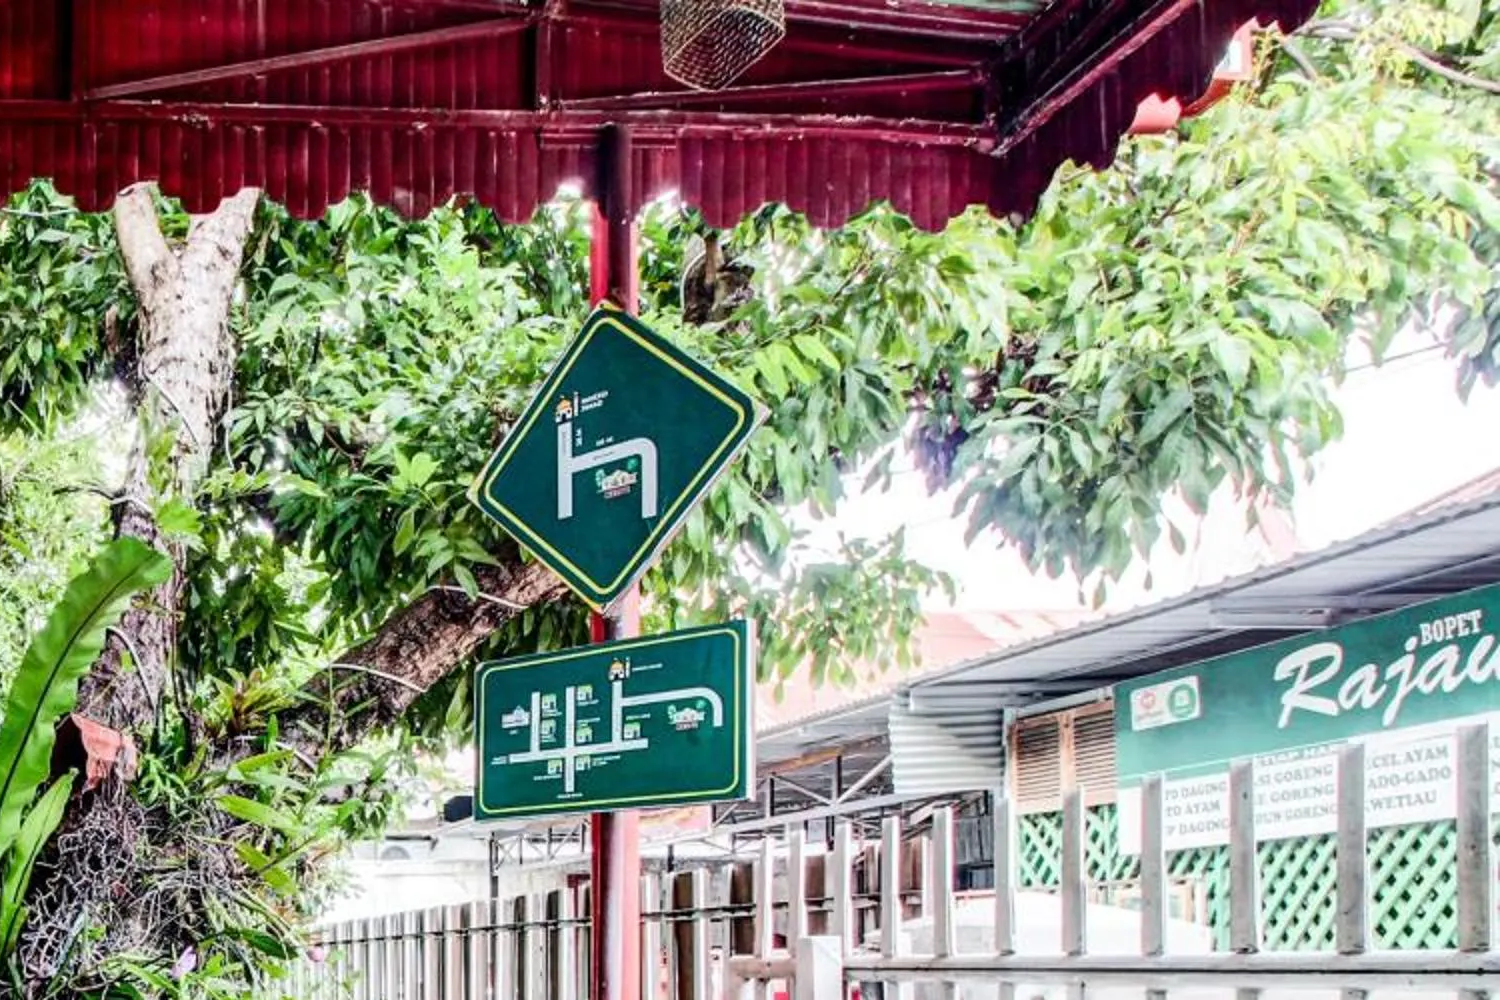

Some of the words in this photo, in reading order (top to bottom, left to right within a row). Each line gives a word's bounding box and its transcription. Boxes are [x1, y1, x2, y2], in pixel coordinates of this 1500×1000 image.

[1420, 609, 1482, 646] BOPET
[1367, 753, 1401, 770] CEL
[1404, 744, 1449, 765] AYAM
[1274, 764, 1333, 783] GORENG
[1185, 799, 1221, 815] AYAM
